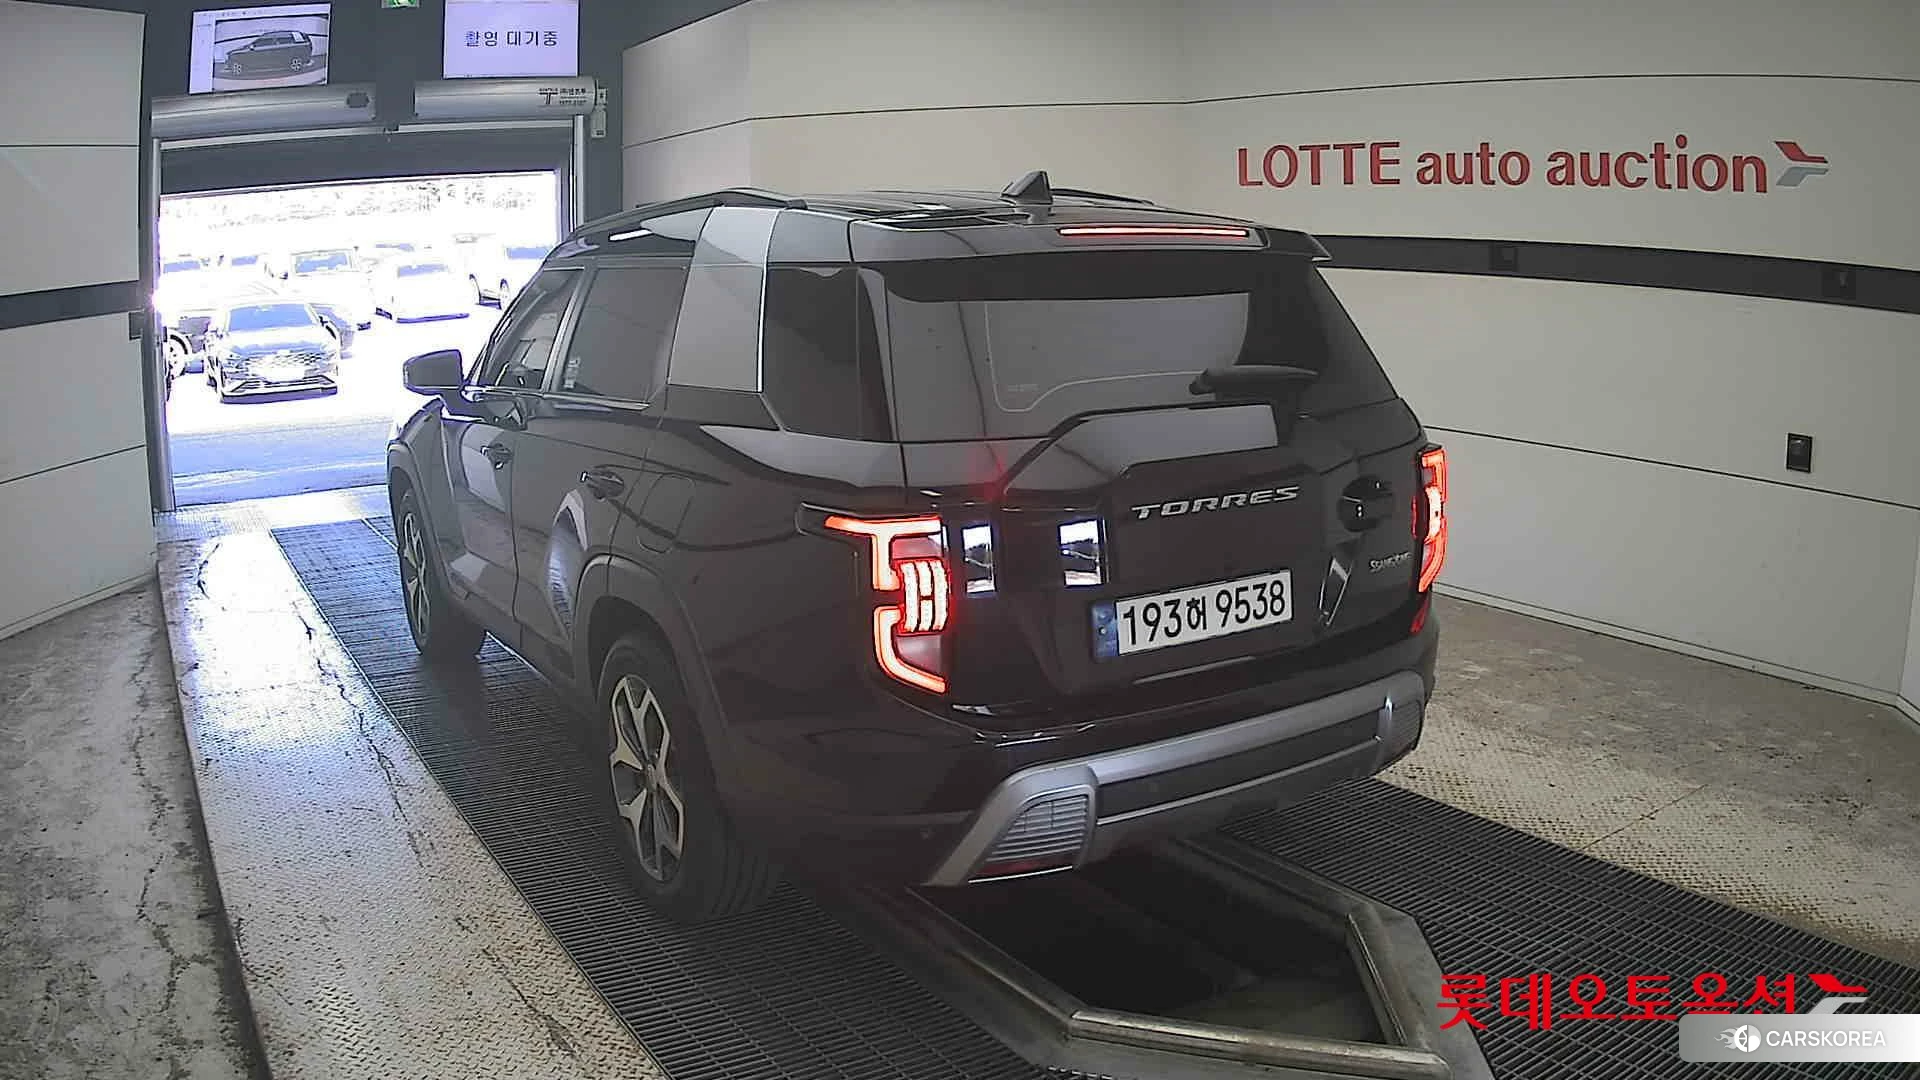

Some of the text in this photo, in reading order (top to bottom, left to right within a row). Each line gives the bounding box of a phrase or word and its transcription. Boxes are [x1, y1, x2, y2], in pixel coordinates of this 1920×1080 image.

[506, 30, 557, 47] 대기중
[1237, 135, 1767, 192] LOTTE auto auction
[1130, 486, 1300, 520] TORRES
[1122, 580, 1286, 645] 193허 9538
